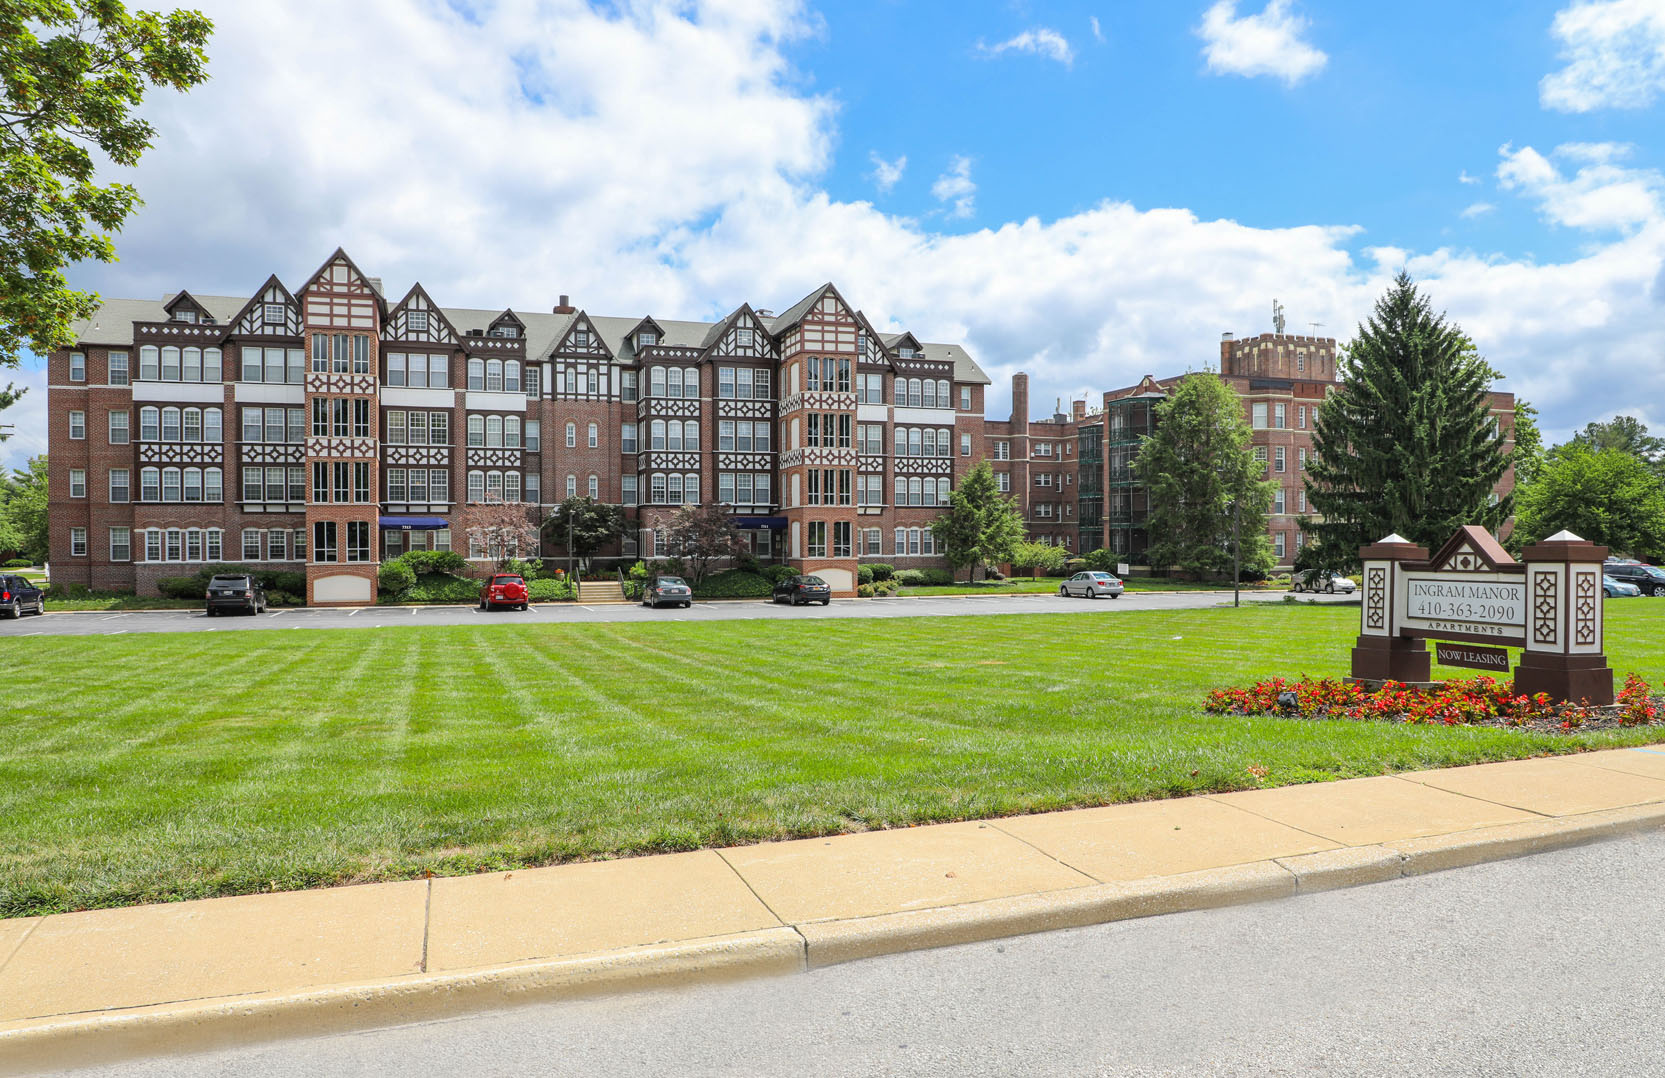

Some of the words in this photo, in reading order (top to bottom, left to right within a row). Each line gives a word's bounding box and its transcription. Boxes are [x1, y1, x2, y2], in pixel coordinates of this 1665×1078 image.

[1414, 584, 1465, 598] INGRAM
[1469, 586, 1519, 600] MANOR
[1418, 600, 1514, 620] 410-363-2090
[1428, 622, 1503, 635] APARTMENTS
[1438, 649, 1461, 660] NOW
[1463, 651, 1506, 666] LEASING
